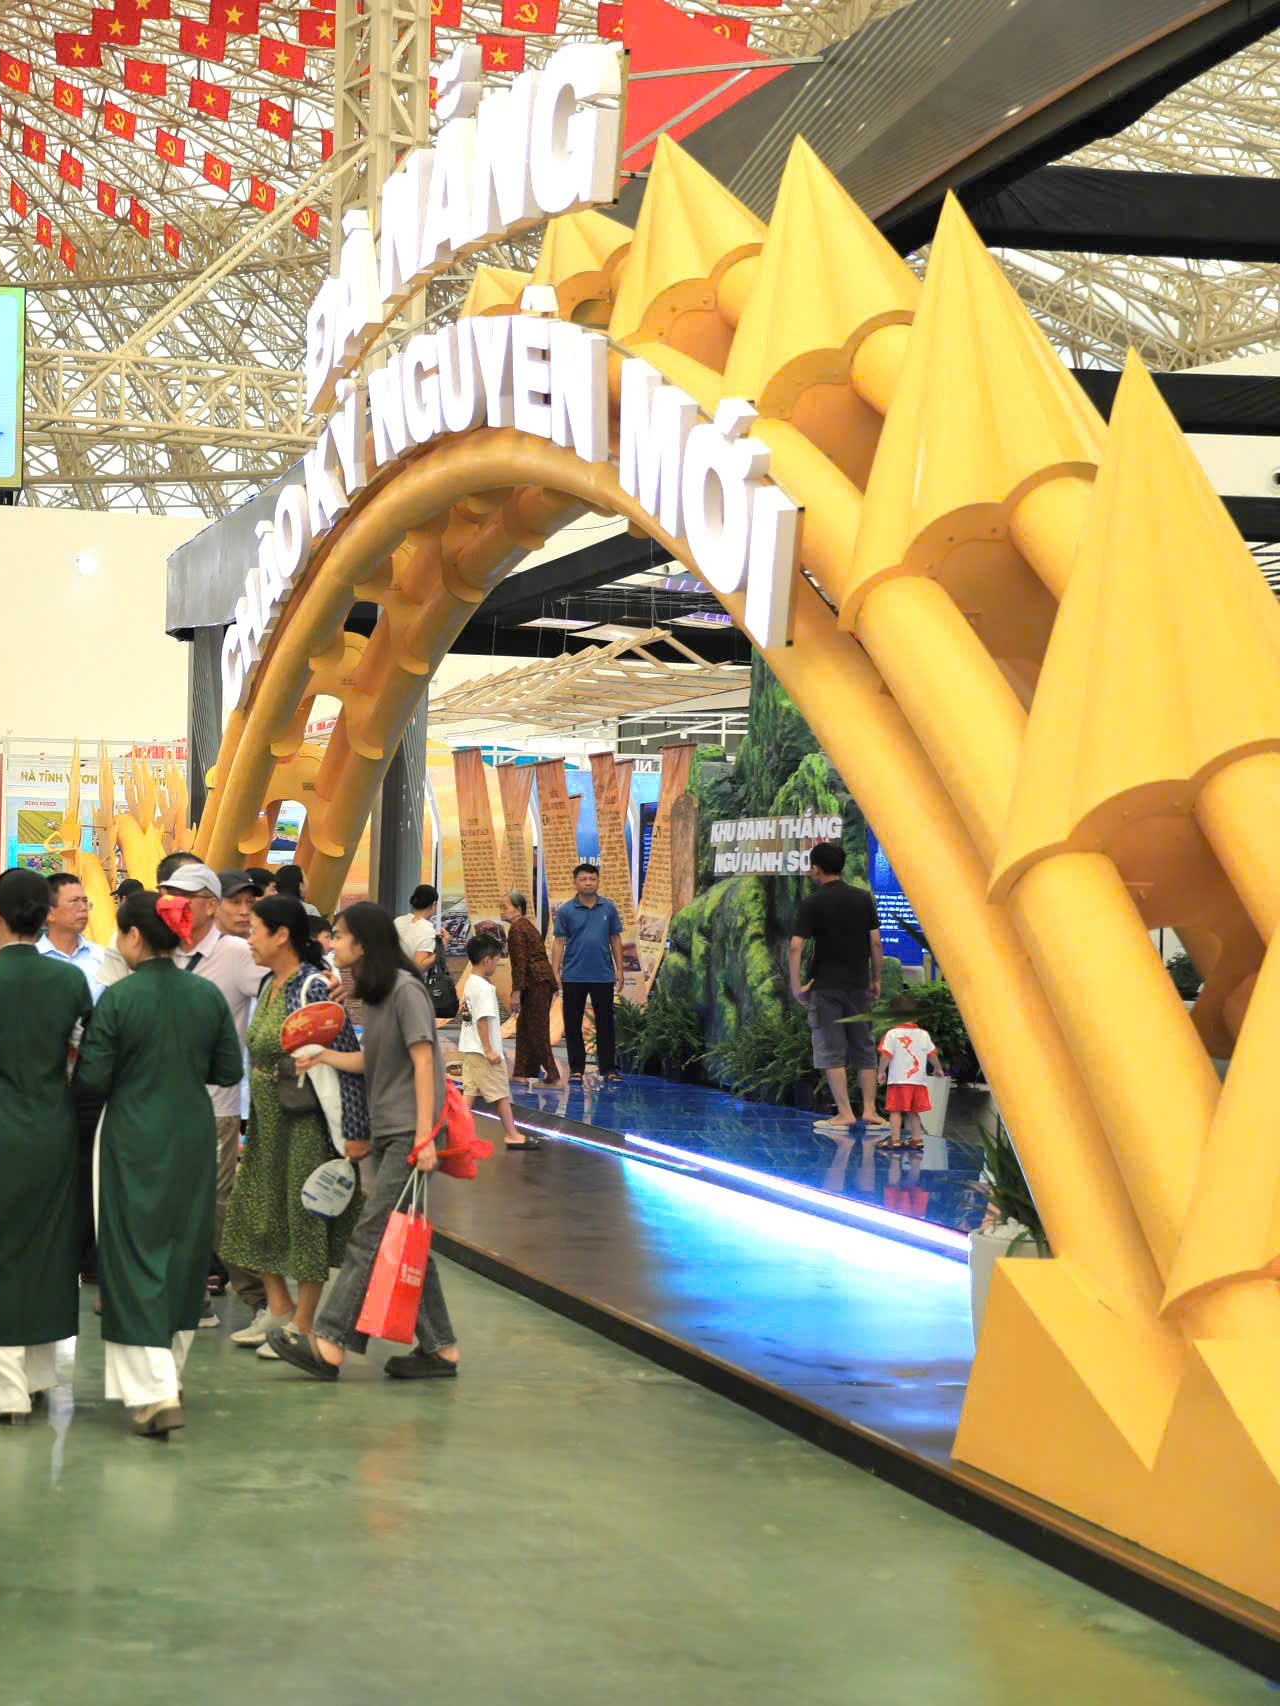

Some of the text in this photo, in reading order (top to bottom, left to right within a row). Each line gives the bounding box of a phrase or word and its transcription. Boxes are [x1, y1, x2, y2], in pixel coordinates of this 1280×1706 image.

[306, 209, 384, 410] ĐÀ
[221, 484, 312, 711] CHÀO
[368, 284, 608, 466] NGUYÊN
[619, 357, 798, 650] MỚI
[20, 769, 36, 782] HÀ
[39, 769, 63, 783] TĨNH
[710, 807, 842, 842] KHU DANH THẮNG
[741, 847, 784, 873] HÀNH
